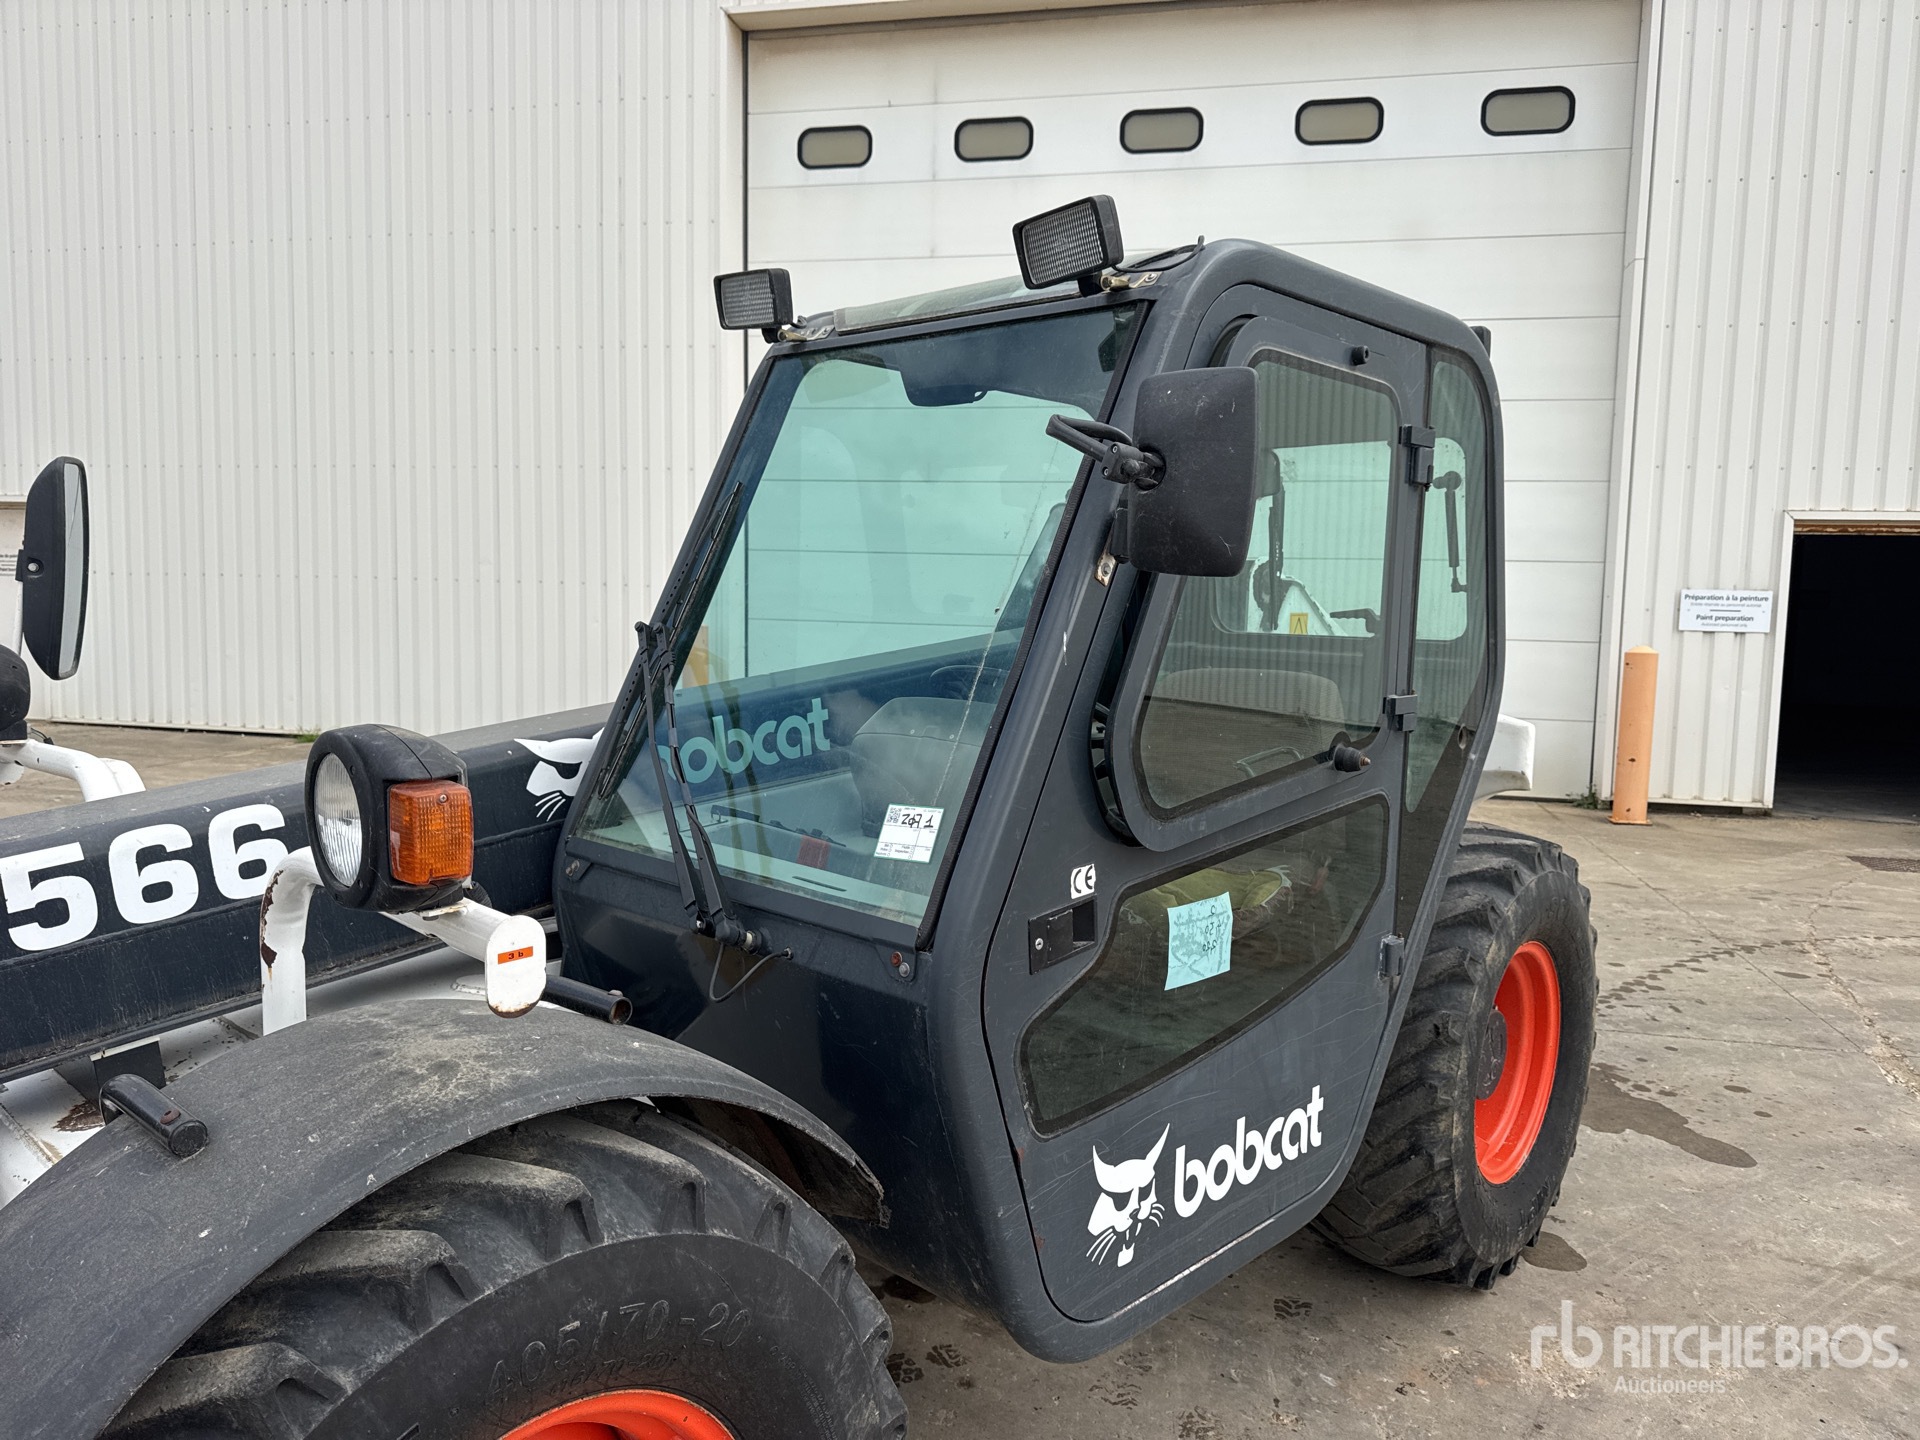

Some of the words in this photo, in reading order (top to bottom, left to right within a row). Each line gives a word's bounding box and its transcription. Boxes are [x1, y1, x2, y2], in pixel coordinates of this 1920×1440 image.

[1684, 593, 1724, 602] Préparation
[1739, 595, 1769, 603] peinture
[0, 804, 289, 952] 566
[1174, 1085, 1324, 1218] bobcat
